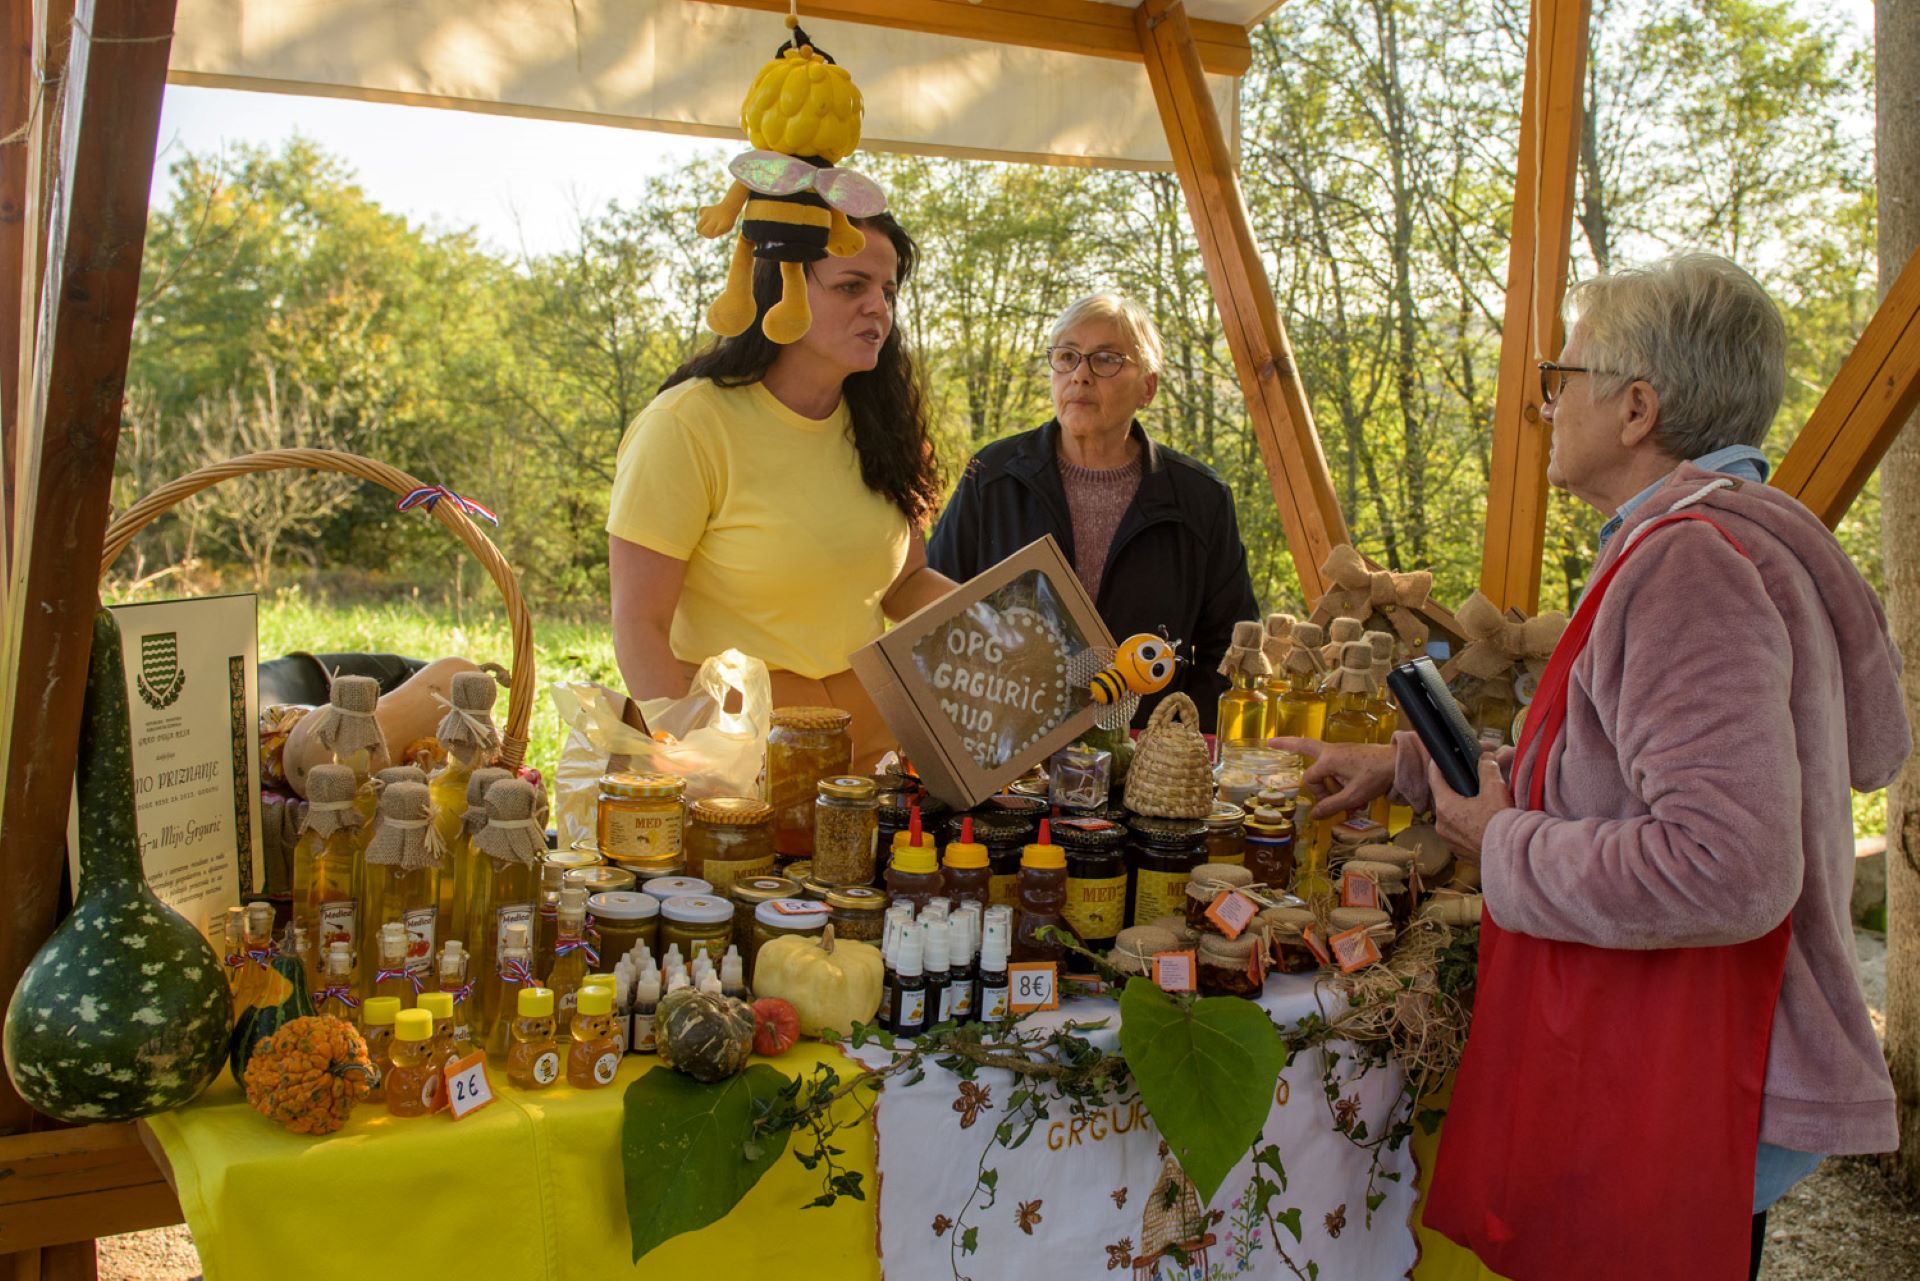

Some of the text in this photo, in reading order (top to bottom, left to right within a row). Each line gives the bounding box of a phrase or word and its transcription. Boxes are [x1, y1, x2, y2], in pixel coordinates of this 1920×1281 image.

[948, 628, 1003, 664] OPG
[158, 760, 219, 789] PRIZNANJE
[161, 824, 184, 849] Mijo
[185, 814, 223, 846] Grgurić
[635, 818, 662, 829] MED
[1083, 886, 1116, 903] MED
[1019, 975, 1045, 998] 8€
[1047, 1100, 1151, 1151] GRGUR
